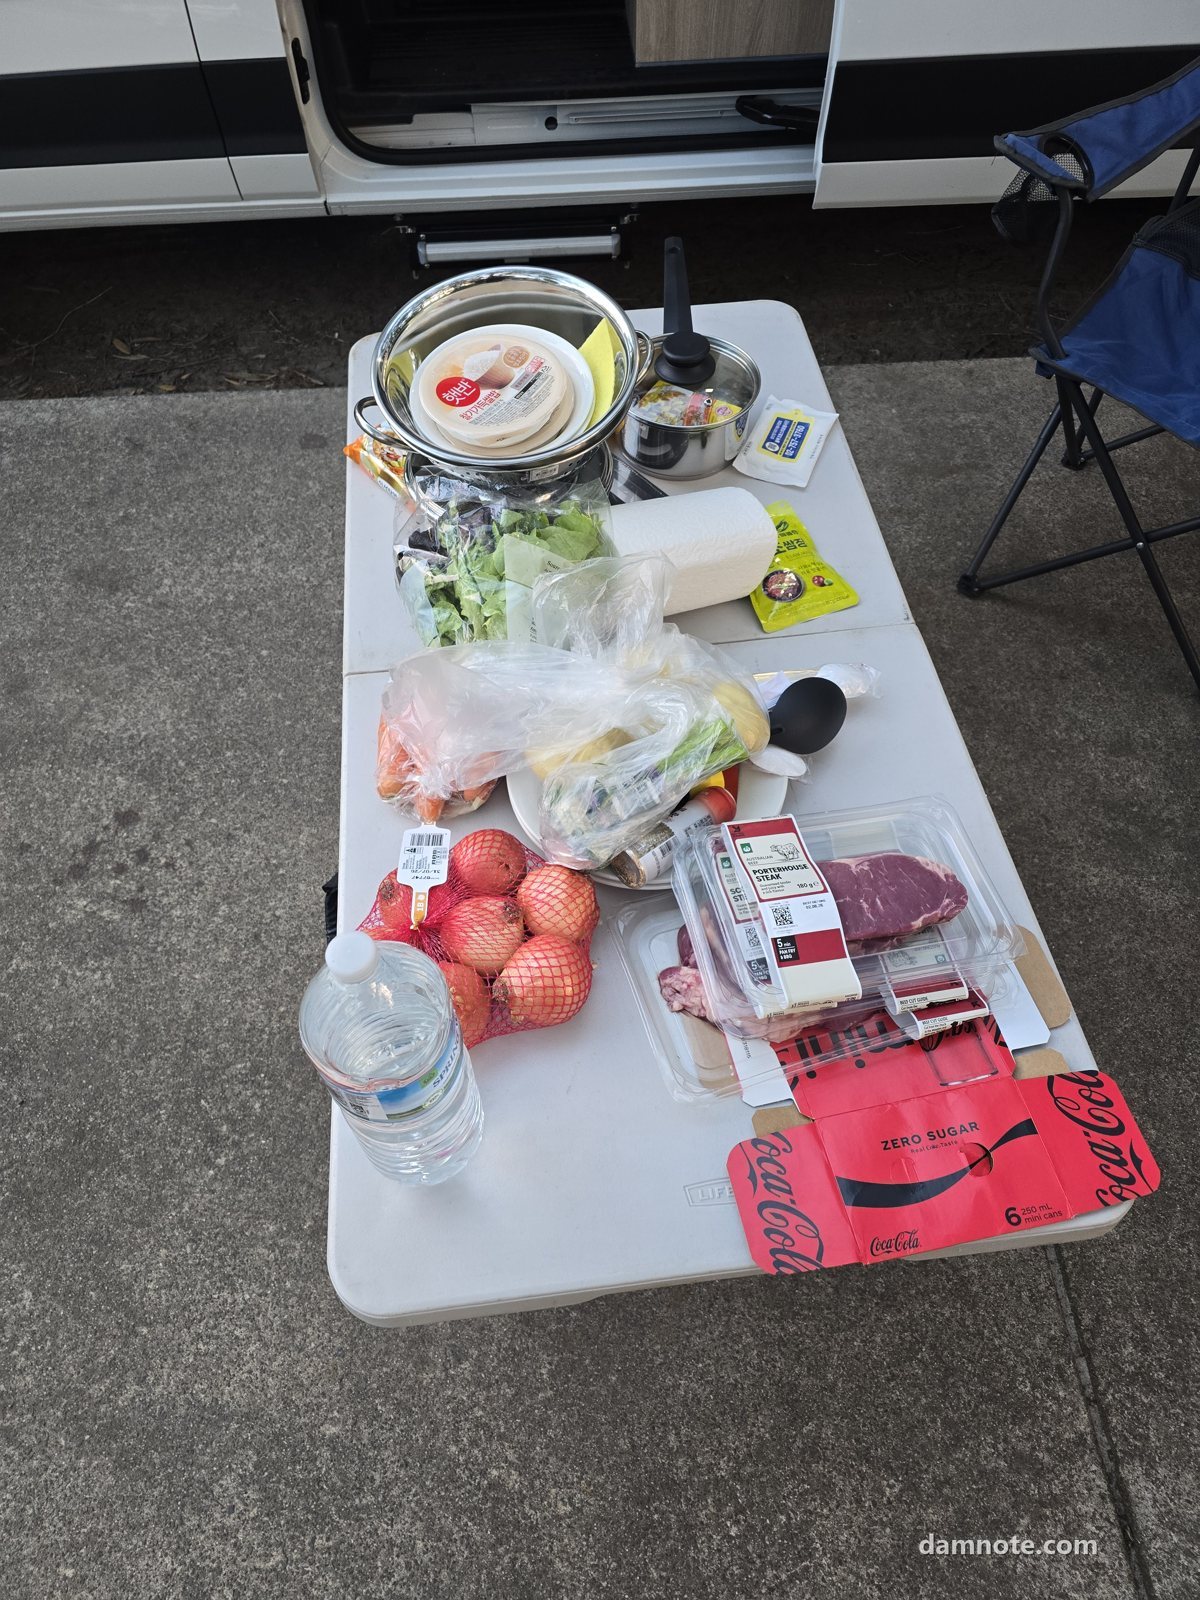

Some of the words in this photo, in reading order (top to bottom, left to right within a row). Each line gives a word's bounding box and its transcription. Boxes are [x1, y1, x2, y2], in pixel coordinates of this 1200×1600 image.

[442, 378, 477, 405] 햇반
[752, 863, 809, 875] PORTERHOUSE
[756, 873, 782, 882] STEAK
[776, 938, 783, 948] 5
[881, 1134, 922, 1151] ZERO
[926, 1121, 980, 1141] SUGAR
[699, 1185, 735, 1200] LIFE
[1004, 1206, 1022, 1227] 6
[1022, 1205, 1036, 1216] 250
[1039, 1203, 1053, 1211] mL
[1024, 1212, 1041, 1224] mini
[1043, 1211, 1063, 1220] cans
[870, 1229, 919, 1256] Coca-Cola
